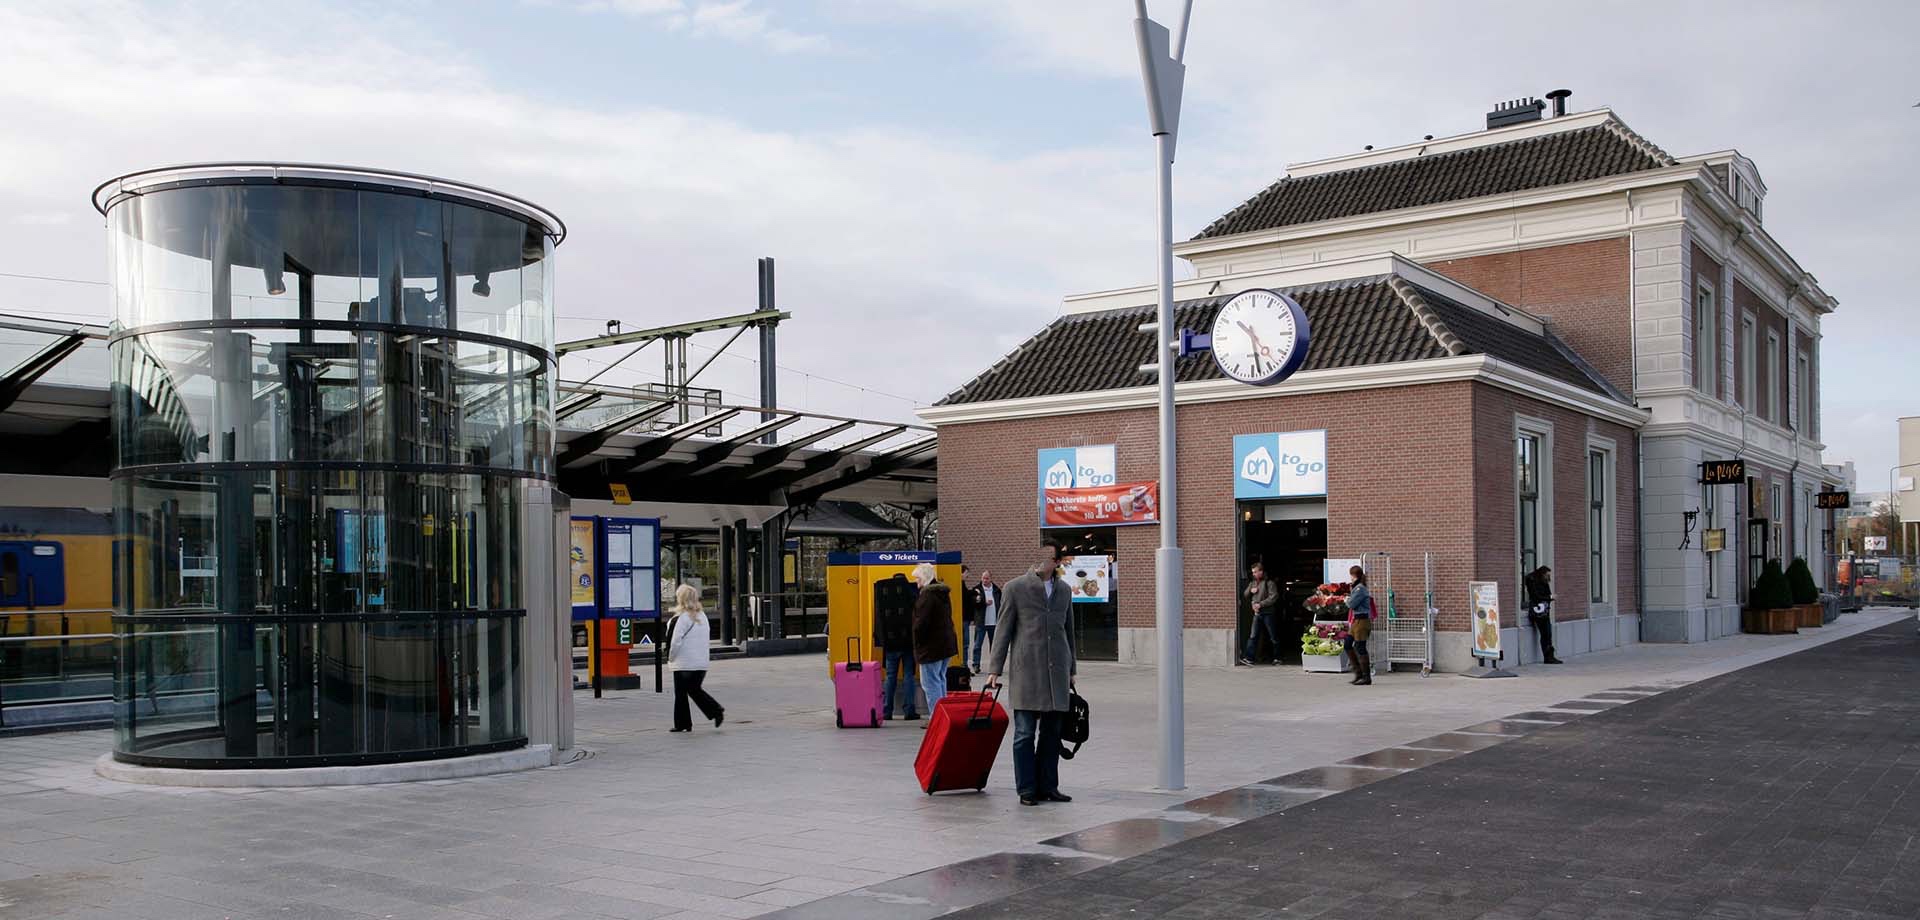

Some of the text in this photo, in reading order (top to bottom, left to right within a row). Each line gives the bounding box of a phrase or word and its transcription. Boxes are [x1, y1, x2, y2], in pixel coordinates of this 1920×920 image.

[1281, 453, 1301, 464] to
[1078, 466, 1095, 476] to
[1295, 462, 1323, 476] go
[1090, 474, 1113, 486] go
